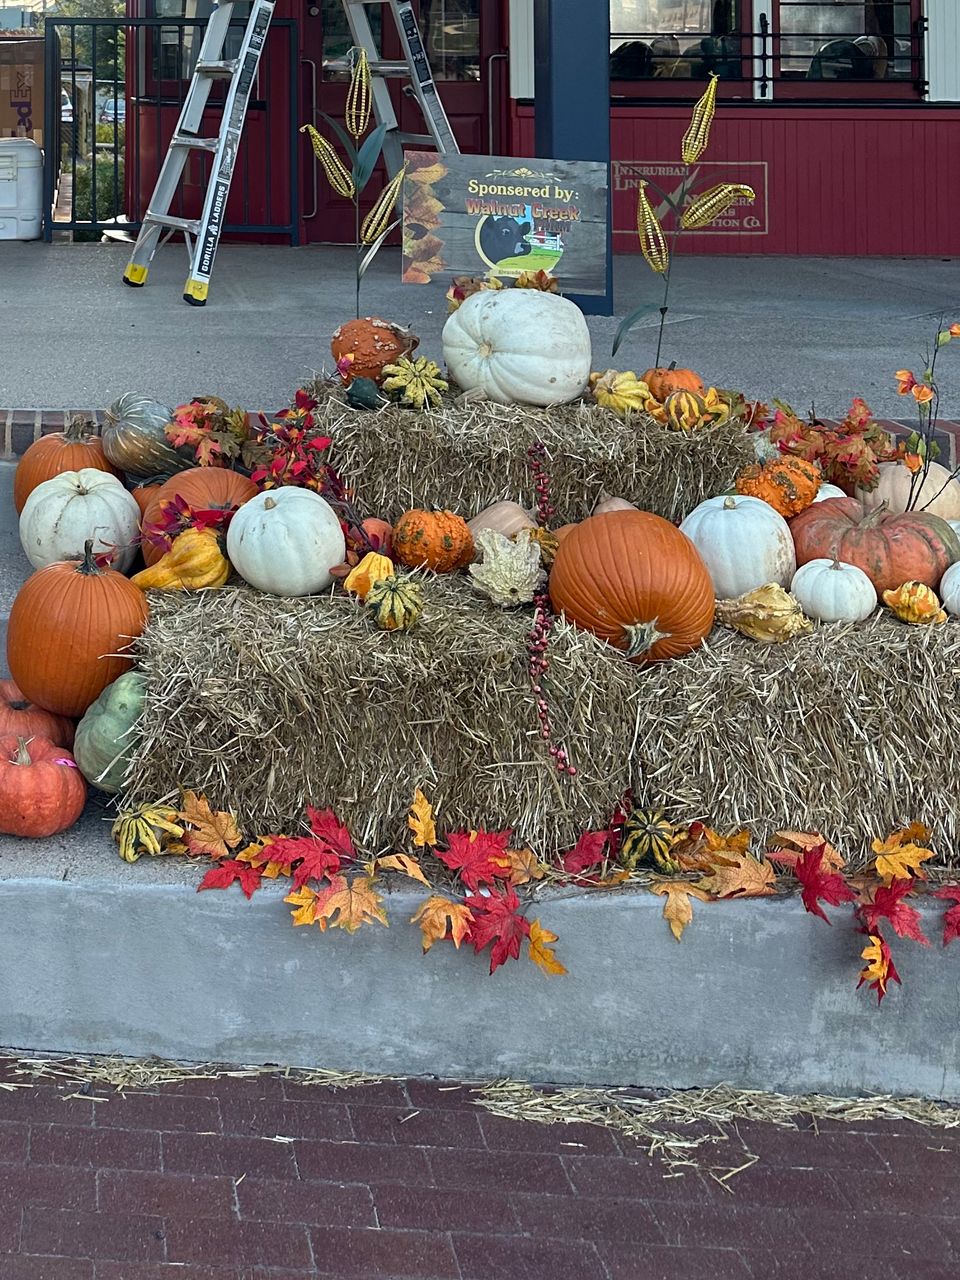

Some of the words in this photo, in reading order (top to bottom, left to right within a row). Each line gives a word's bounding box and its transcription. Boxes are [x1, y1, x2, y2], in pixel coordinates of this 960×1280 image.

[468, 179, 550, 198] Sponsered
[554, 186, 579, 203] by:
[465, 198, 526, 217] Walnut
[531, 201, 581, 221] Creek
[201, 237, 215, 272] GORILLA
[211, 185, 226, 223] LADDERS
